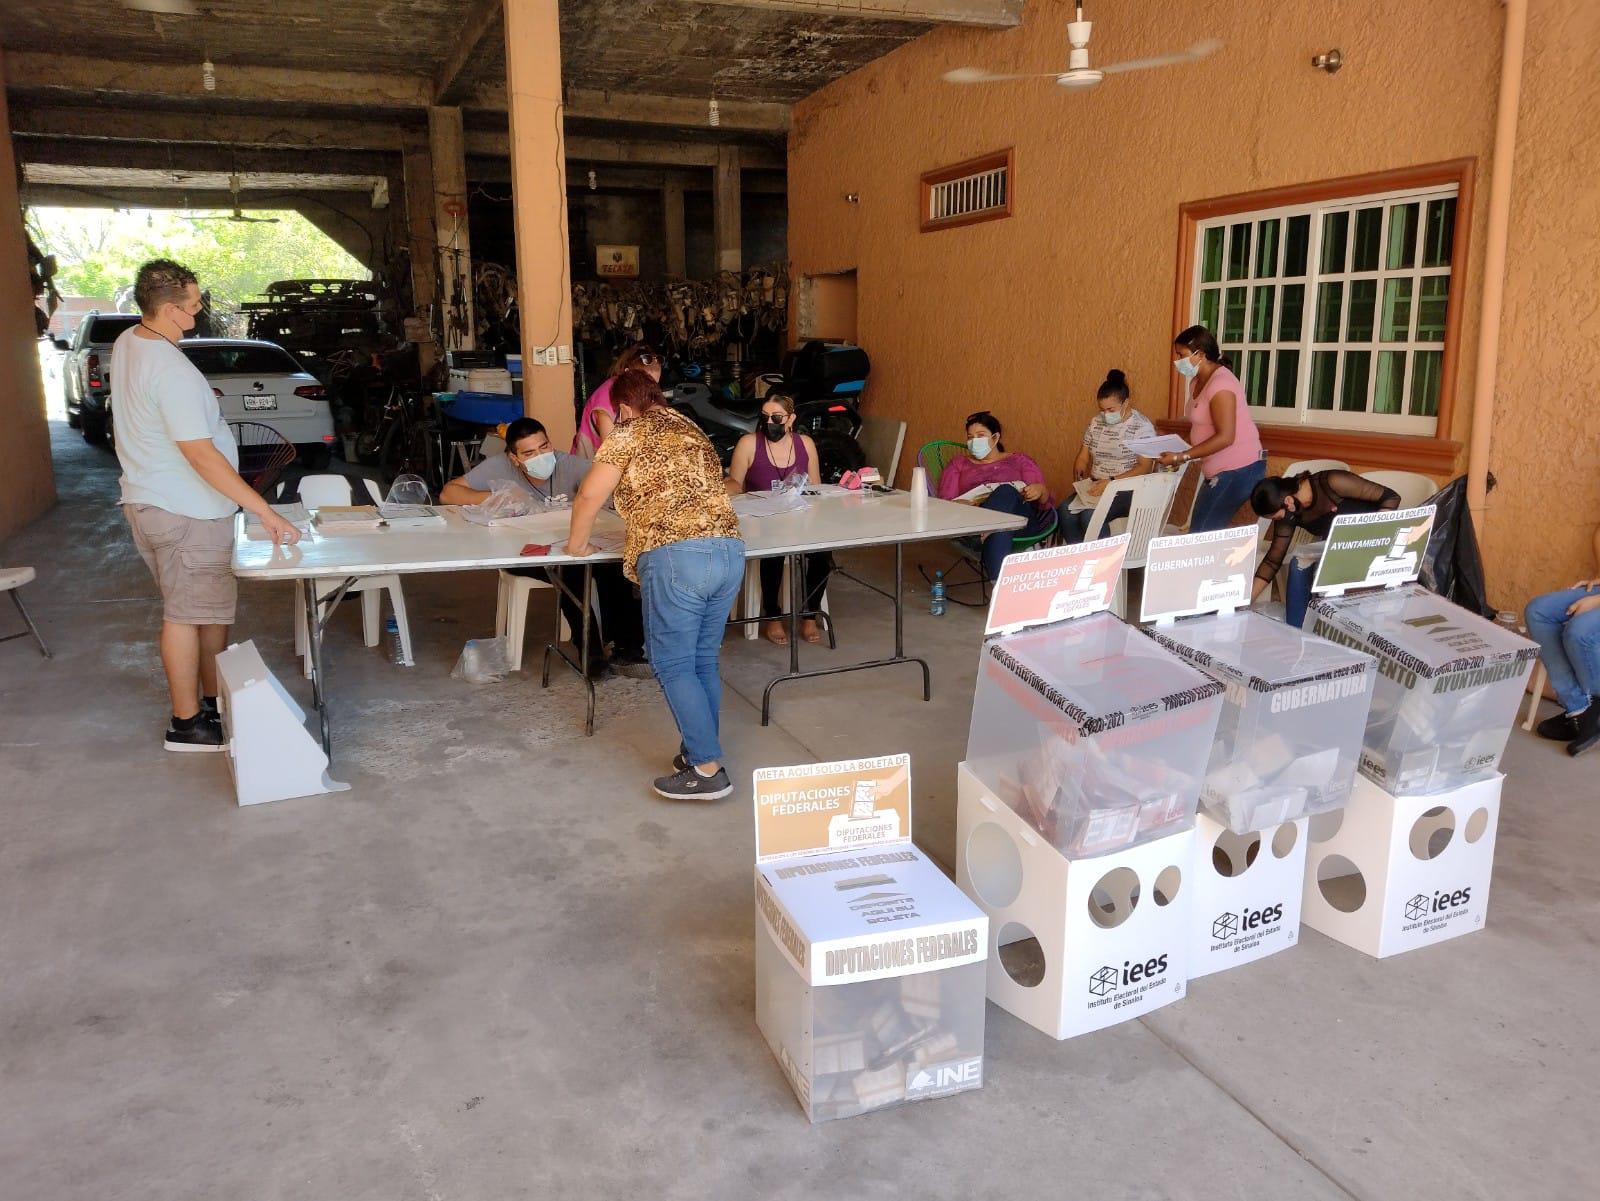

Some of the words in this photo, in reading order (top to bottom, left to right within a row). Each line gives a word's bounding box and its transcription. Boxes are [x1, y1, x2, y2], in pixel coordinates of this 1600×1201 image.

[1336, 517, 1356, 525] META
[1376, 512, 1395, 521] SOLO
[1404, 508, 1427, 518] BOLETA
[1151, 540, 1172, 548] META
[1194, 535, 1214, 544] SOLO
[1214, 532, 1222, 540] LA
[1224, 528, 1248, 538] BOLETA
[1250, 526, 1258, 534] DE
[1330, 538, 1390, 550] AYUNTAMIENTO
[1006, 552, 1030, 564] META
[1055, 546, 1078, 556] SOLO
[1090, 538, 1120, 550] BOLETA
[1150, 555, 1215, 572] GUBERNATURA
[1370, 566, 1412, 576] AYUNTAMIENTO
[1002, 565, 1080, 586] DIPUTACIONES
[1012, 579, 1058, 592] LOCALES
[989, 644, 1018, 672] PROCESO
[1366, 632, 1400, 658] PROCESO
[1397, 650, 1434, 679] ELECTORAL
[1432, 659, 1528, 694] AYUNTAMIENTO
[1161, 690, 1196, 712] PROCESO
[1270, 674, 1368, 714] GUBERNATURA
[756, 770, 784, 780] META
[816, 764, 842, 774] SOLO
[844, 762, 856, 772] LA
[858, 758, 893, 770] BOLETA
[896, 756, 908, 764] DE
[1363, 755, 1386, 778] iees
[1476, 753, 1496, 764] iees
[760, 786, 850, 806] DIPUTACIONES
[772, 798, 840, 816] FEDERALES
[836, 824, 892, 838] DIPUTACIONES
[843, 832, 885, 842] FEDERALES
[775, 858, 860, 880] DIPUTACIONES
[859, 851, 919, 870] FEDERALES
[1432, 886, 1471, 913] iees
[866, 912, 920, 924] BOLETA
[1242, 903, 1282, 931] iees
[826, 938, 914, 976] DIPUTACIONES
[916, 928, 978, 964] FEDERALES
[1210, 940, 1233, 952] Instituto
[1241, 940, 1260, 950] Sinaloa
[1123, 954, 1168, 986] iees
[1088, 996, 1112, 1010] Instituto
[1114, 988, 1139, 1002] Electoral
[1149, 978, 1166, 990] Estado
[1114, 1002, 1122, 1010] de
[1122, 994, 1143, 1008] Sinaloa
[936, 1060, 980, 1088] INE
